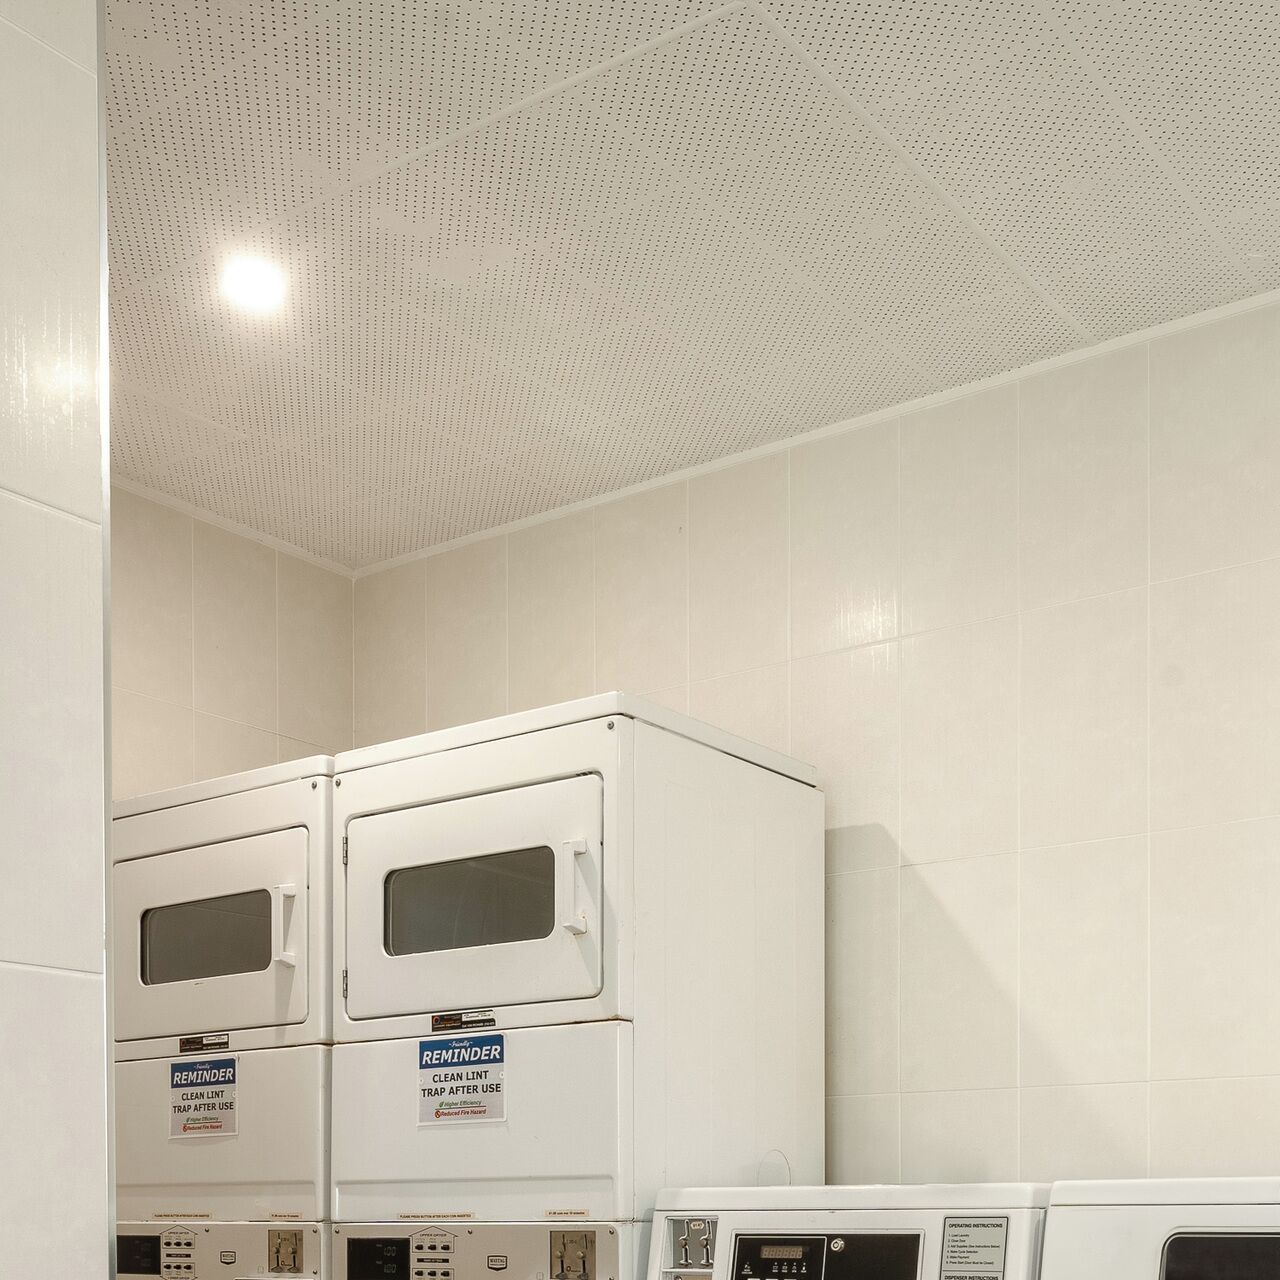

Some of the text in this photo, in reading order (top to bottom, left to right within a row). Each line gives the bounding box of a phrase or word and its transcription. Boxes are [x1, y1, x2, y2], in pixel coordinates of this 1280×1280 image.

[422, 1046, 500, 1064] REMINDER
[174, 1068, 233, 1084] REMINDER
[433, 1071, 488, 1083] CLEAN LINT
[182, 1090, 224, 1100] CLEAN LINT
[422, 1084, 501, 1097] TRAP AFTER USE
[173, 1102, 233, 1113] TRAP AFTER USE
